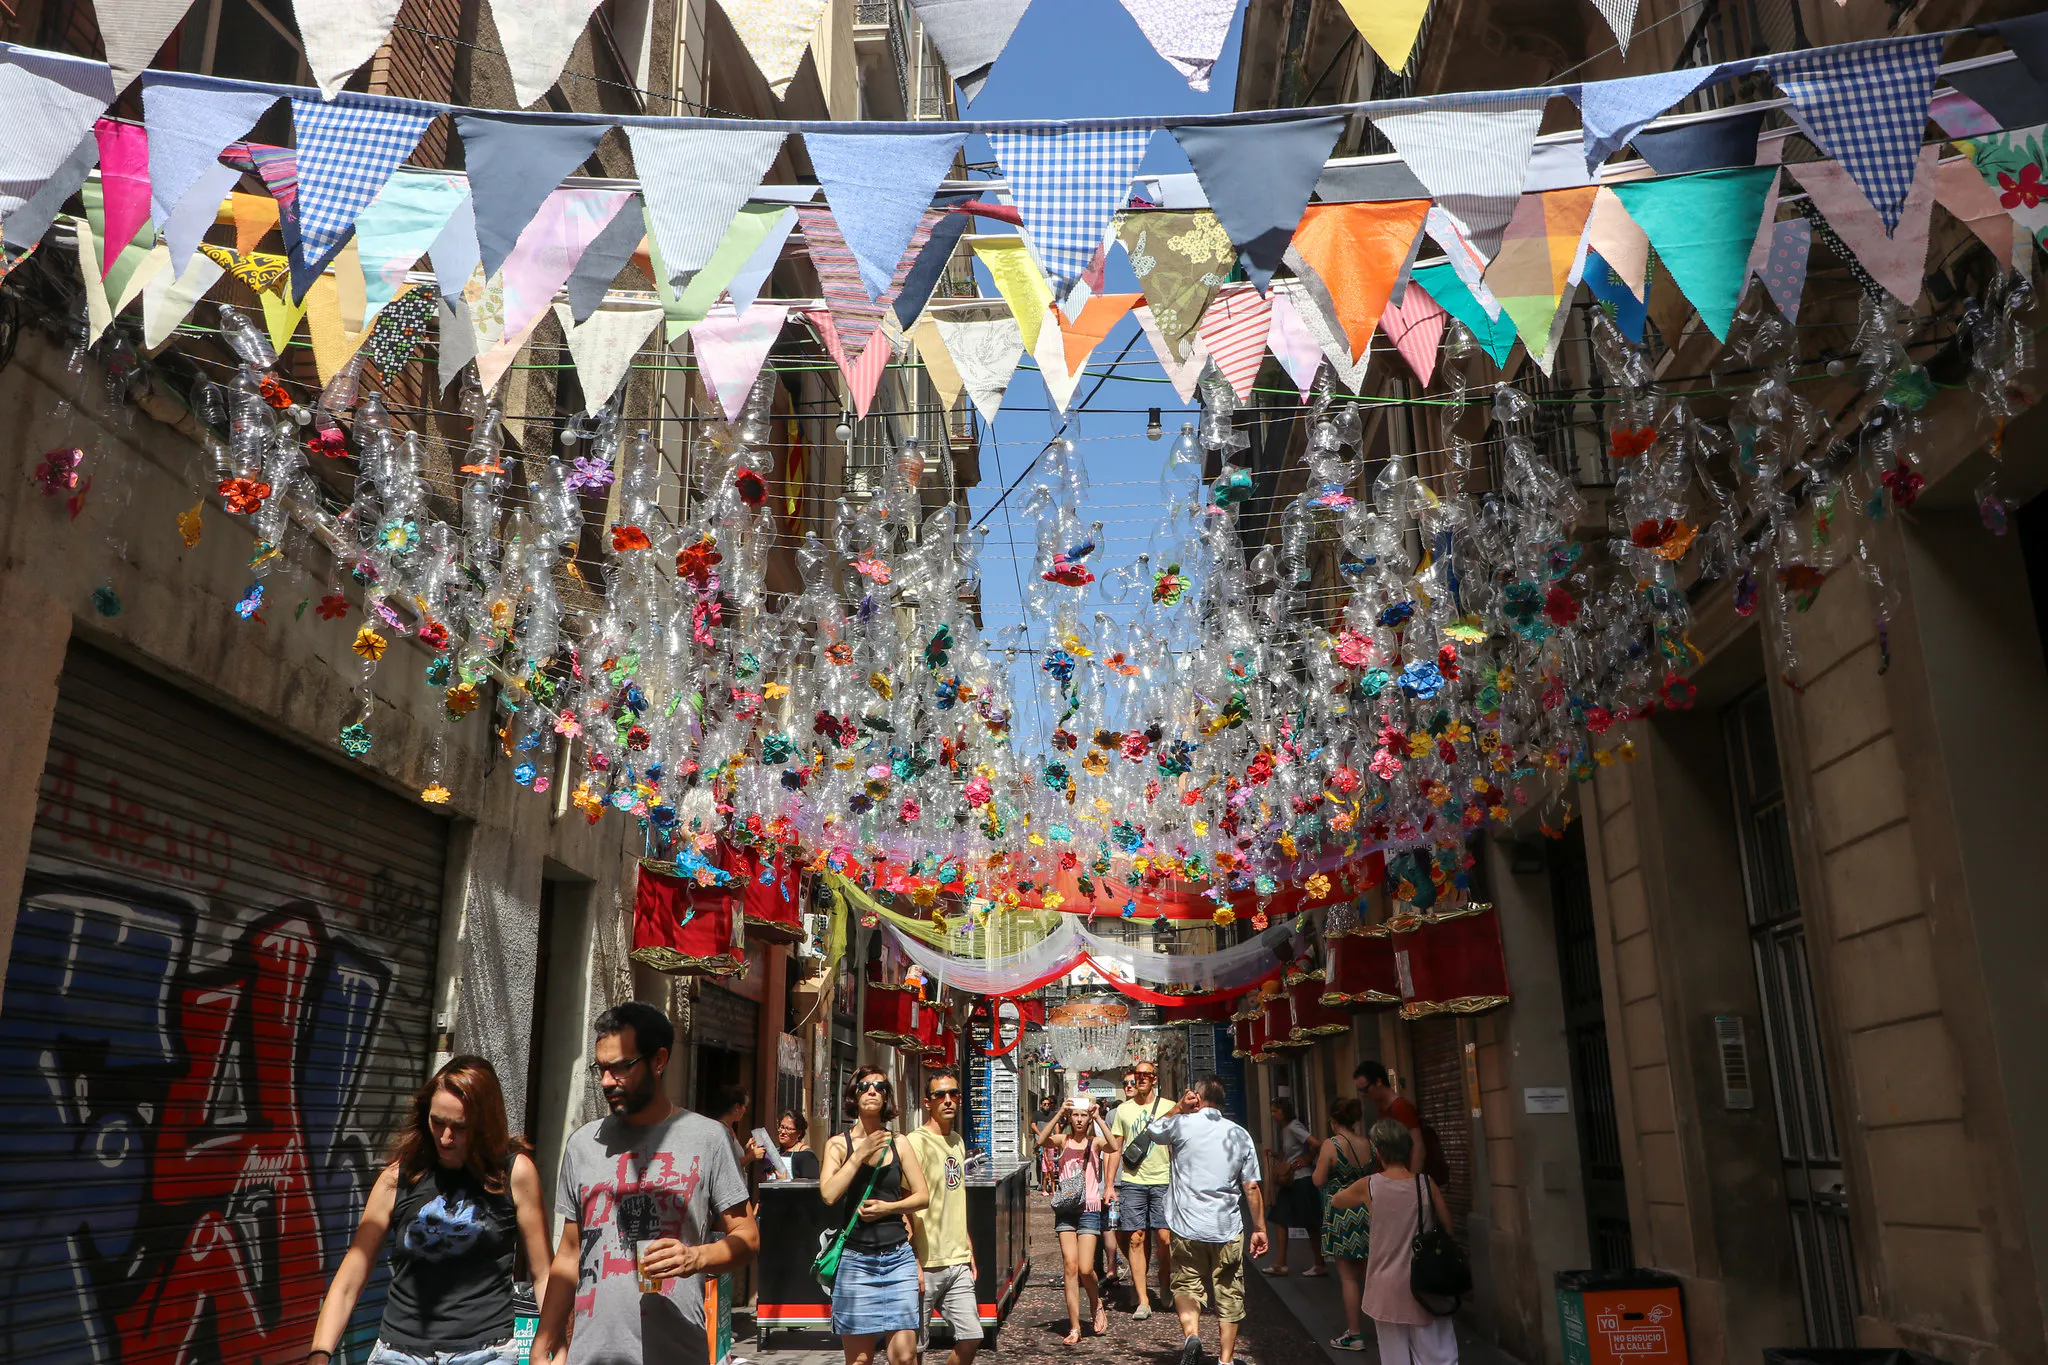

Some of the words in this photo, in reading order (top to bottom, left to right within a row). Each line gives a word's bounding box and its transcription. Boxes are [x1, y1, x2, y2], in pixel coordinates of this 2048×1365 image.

[1600, 1318, 1616, 1329] YO
[1613, 1334, 1625, 1342] NO
[1626, 1333, 1662, 1342] ENSUCIO
[1614, 1343, 1626, 1351] LA
[1626, 1342, 1653, 1351] CALLE
